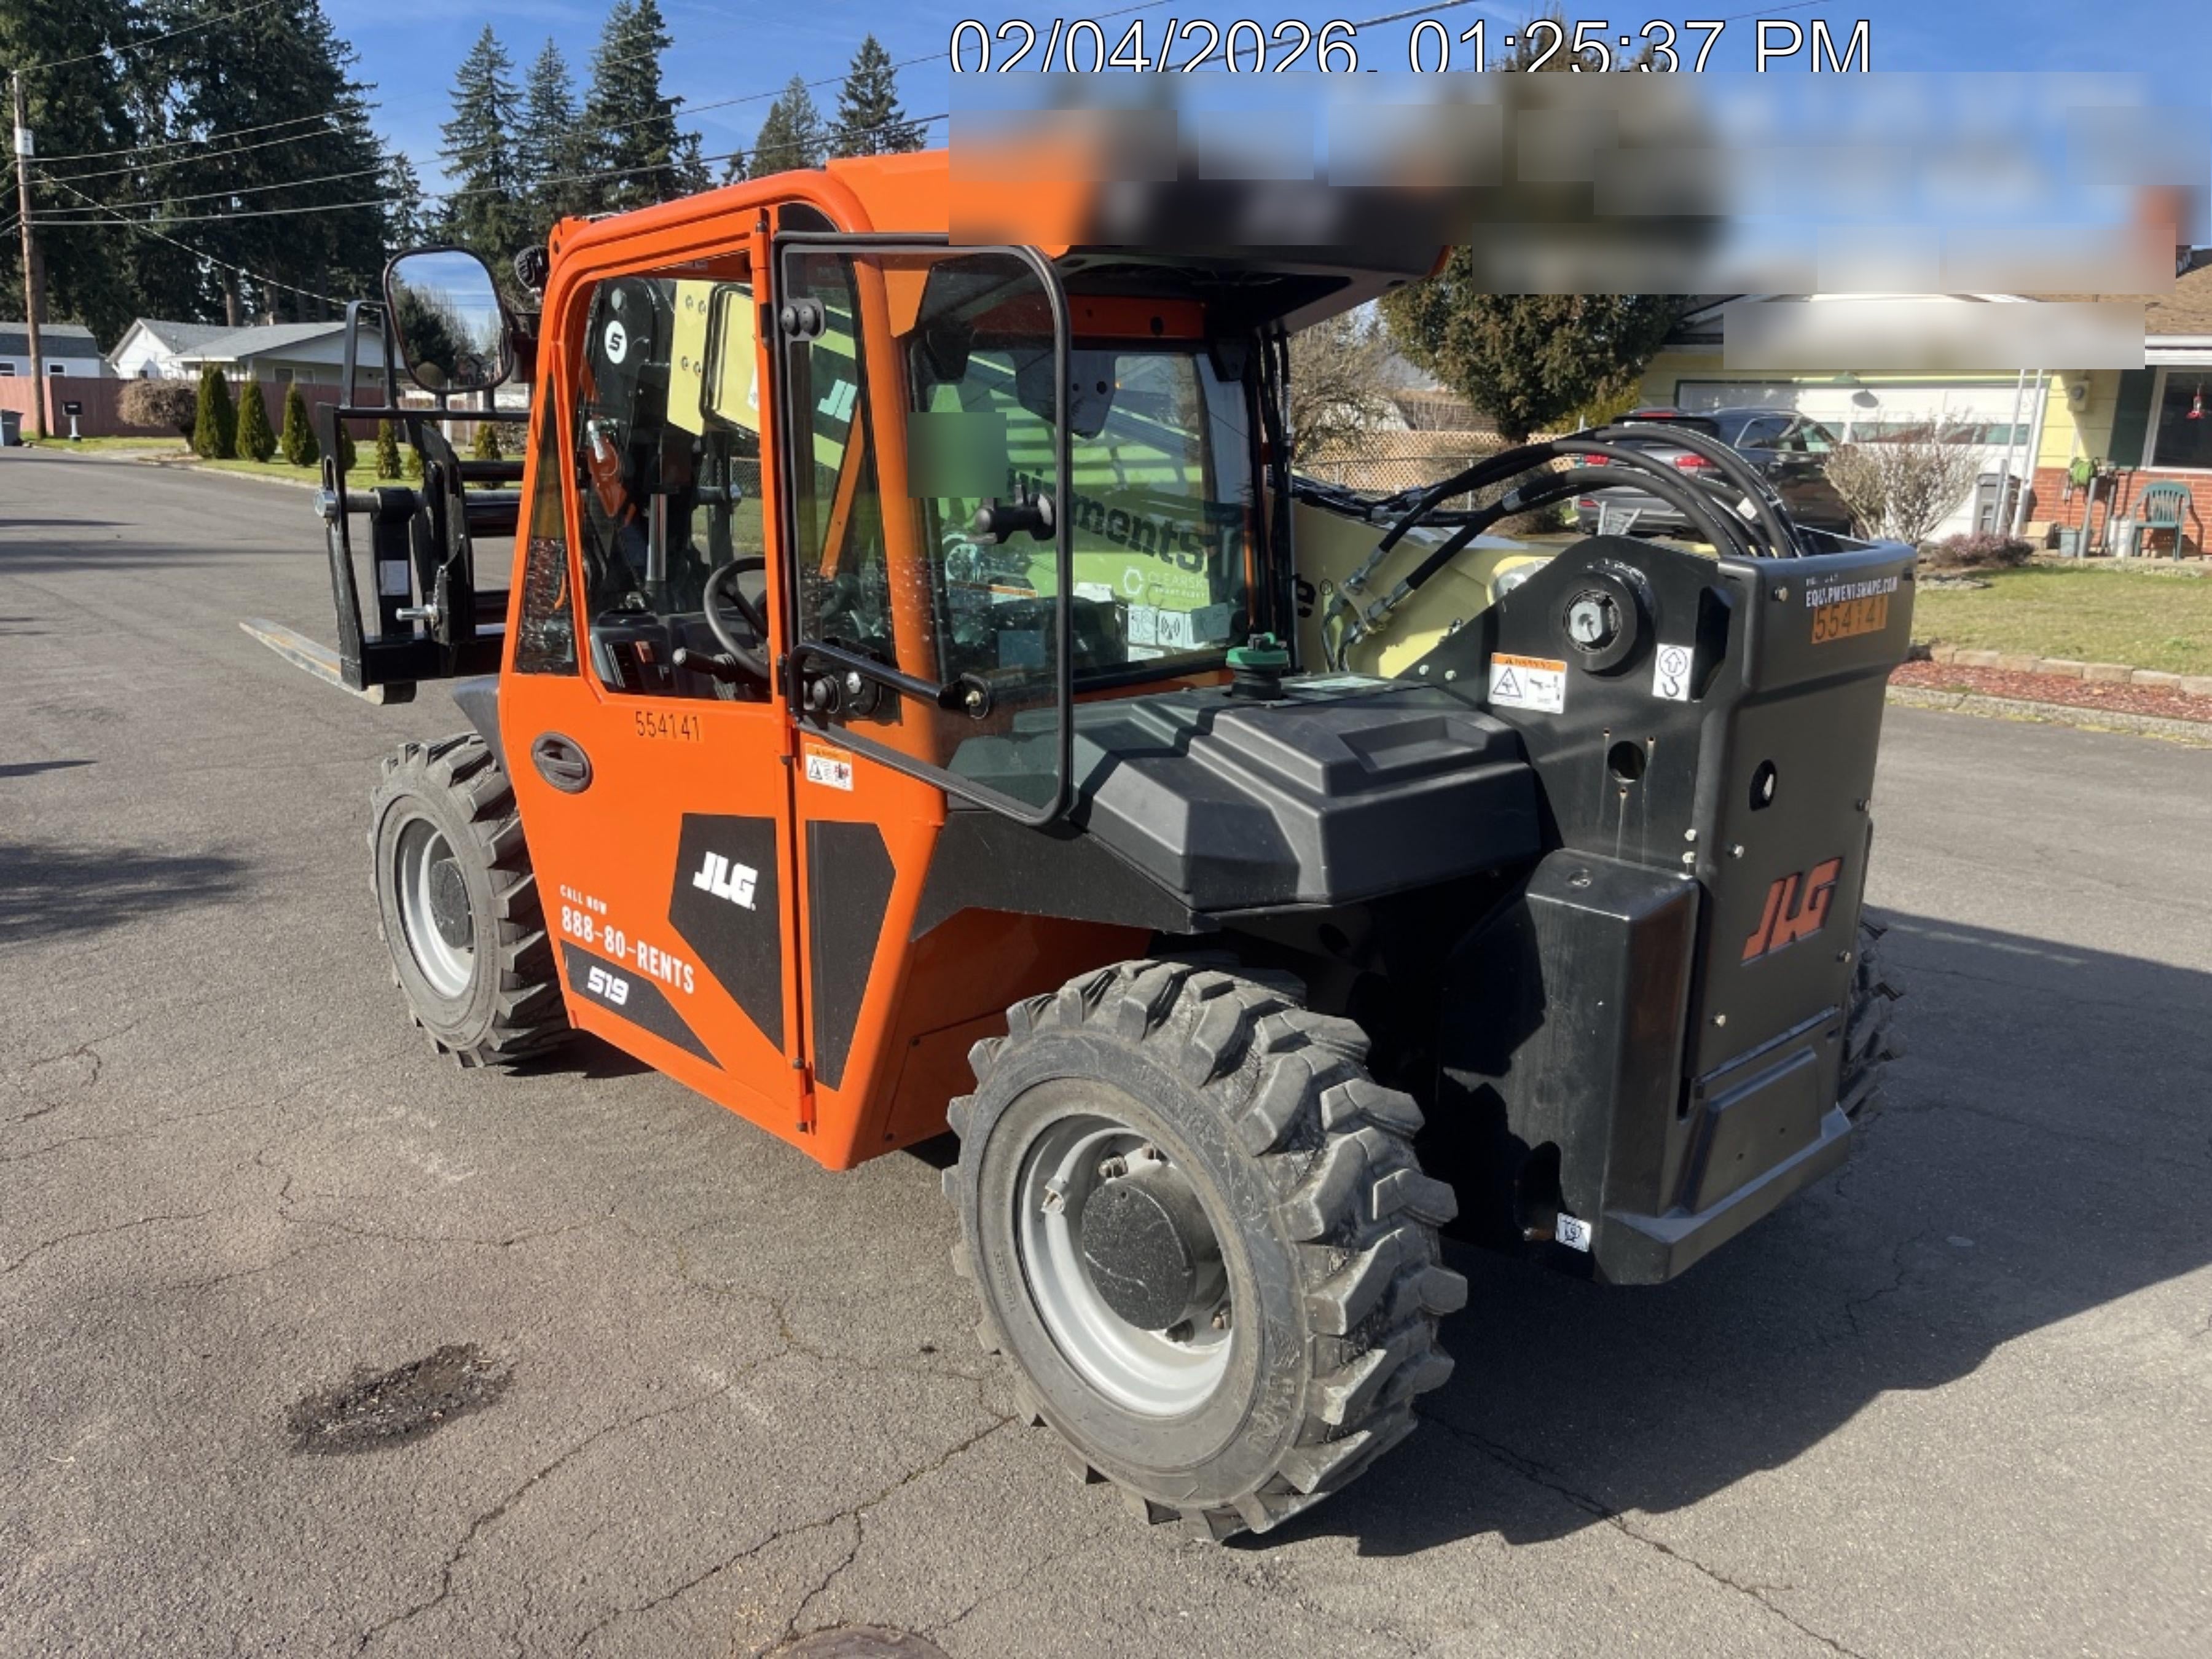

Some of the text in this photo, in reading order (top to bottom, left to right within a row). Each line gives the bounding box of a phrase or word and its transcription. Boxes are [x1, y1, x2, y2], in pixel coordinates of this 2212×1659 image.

[1815, 597, 1885, 640] 554141
[635, 710, 699, 742] 554141
[560, 884, 608, 915] CALL NOW
[692, 851, 758, 909] JLG
[1741, 857, 1842, 965] JLG
[561, 904, 695, 995] 888-80-RENTS
[587, 965, 630, 1006] 519
